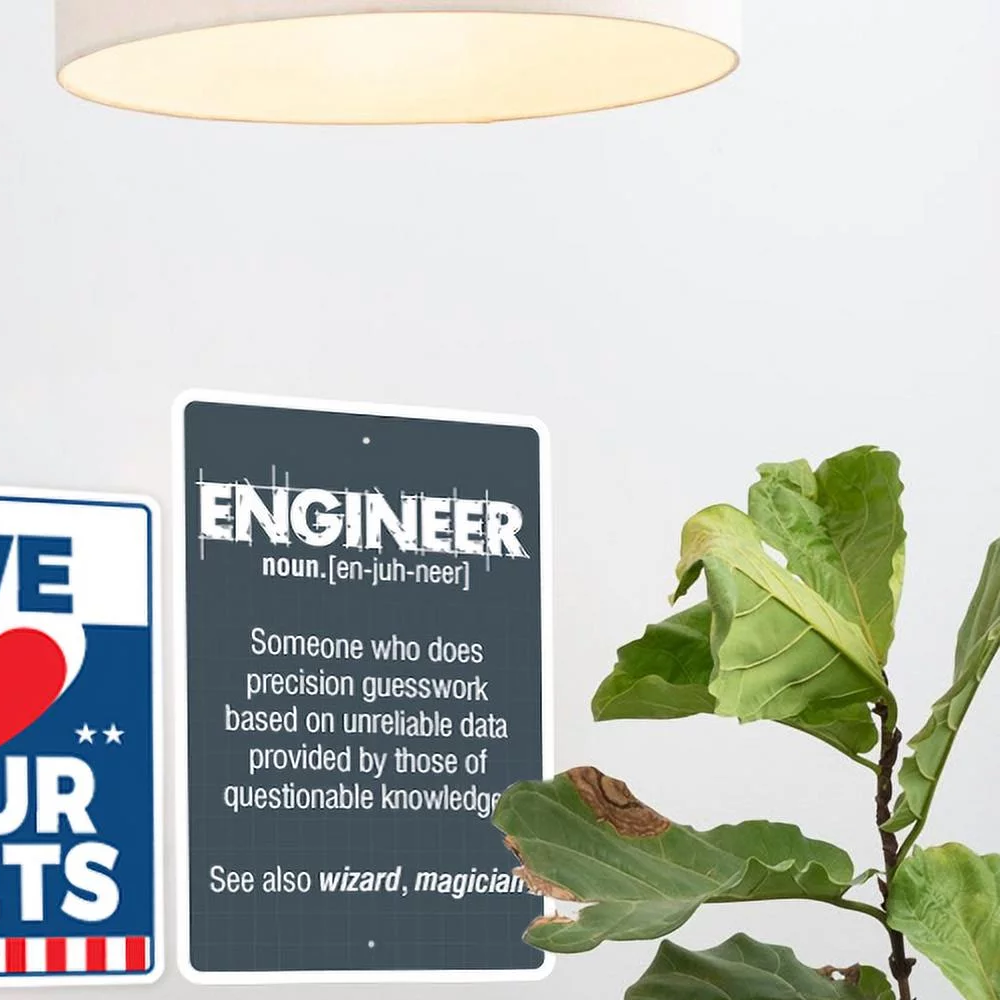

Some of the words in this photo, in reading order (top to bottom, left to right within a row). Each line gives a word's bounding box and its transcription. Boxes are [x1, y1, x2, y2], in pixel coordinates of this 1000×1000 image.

[195, 475, 531, 563] ENGINEER
[251, 627, 364, 659] Someone
[370, 634, 420, 661] who
[427, 636, 484, 663] does
[247, 668, 354, 700] precision
[362, 675, 489, 703] guesswork
[225, 703, 298, 732] based
[306, 711, 334, 733] on
[343, 709, 453, 737] unreliable
[460, 711, 508, 739] data
[249, 743, 351, 775] provided
[359, 746, 387, 779] by
[394, 747, 458, 774] those
[464, 748, 488, 774] of
[224, 782, 374, 812] questionable
[210, 865, 254, 893] See
[263, 865, 311, 893] also
[319, 865, 408, 896] wizard,
